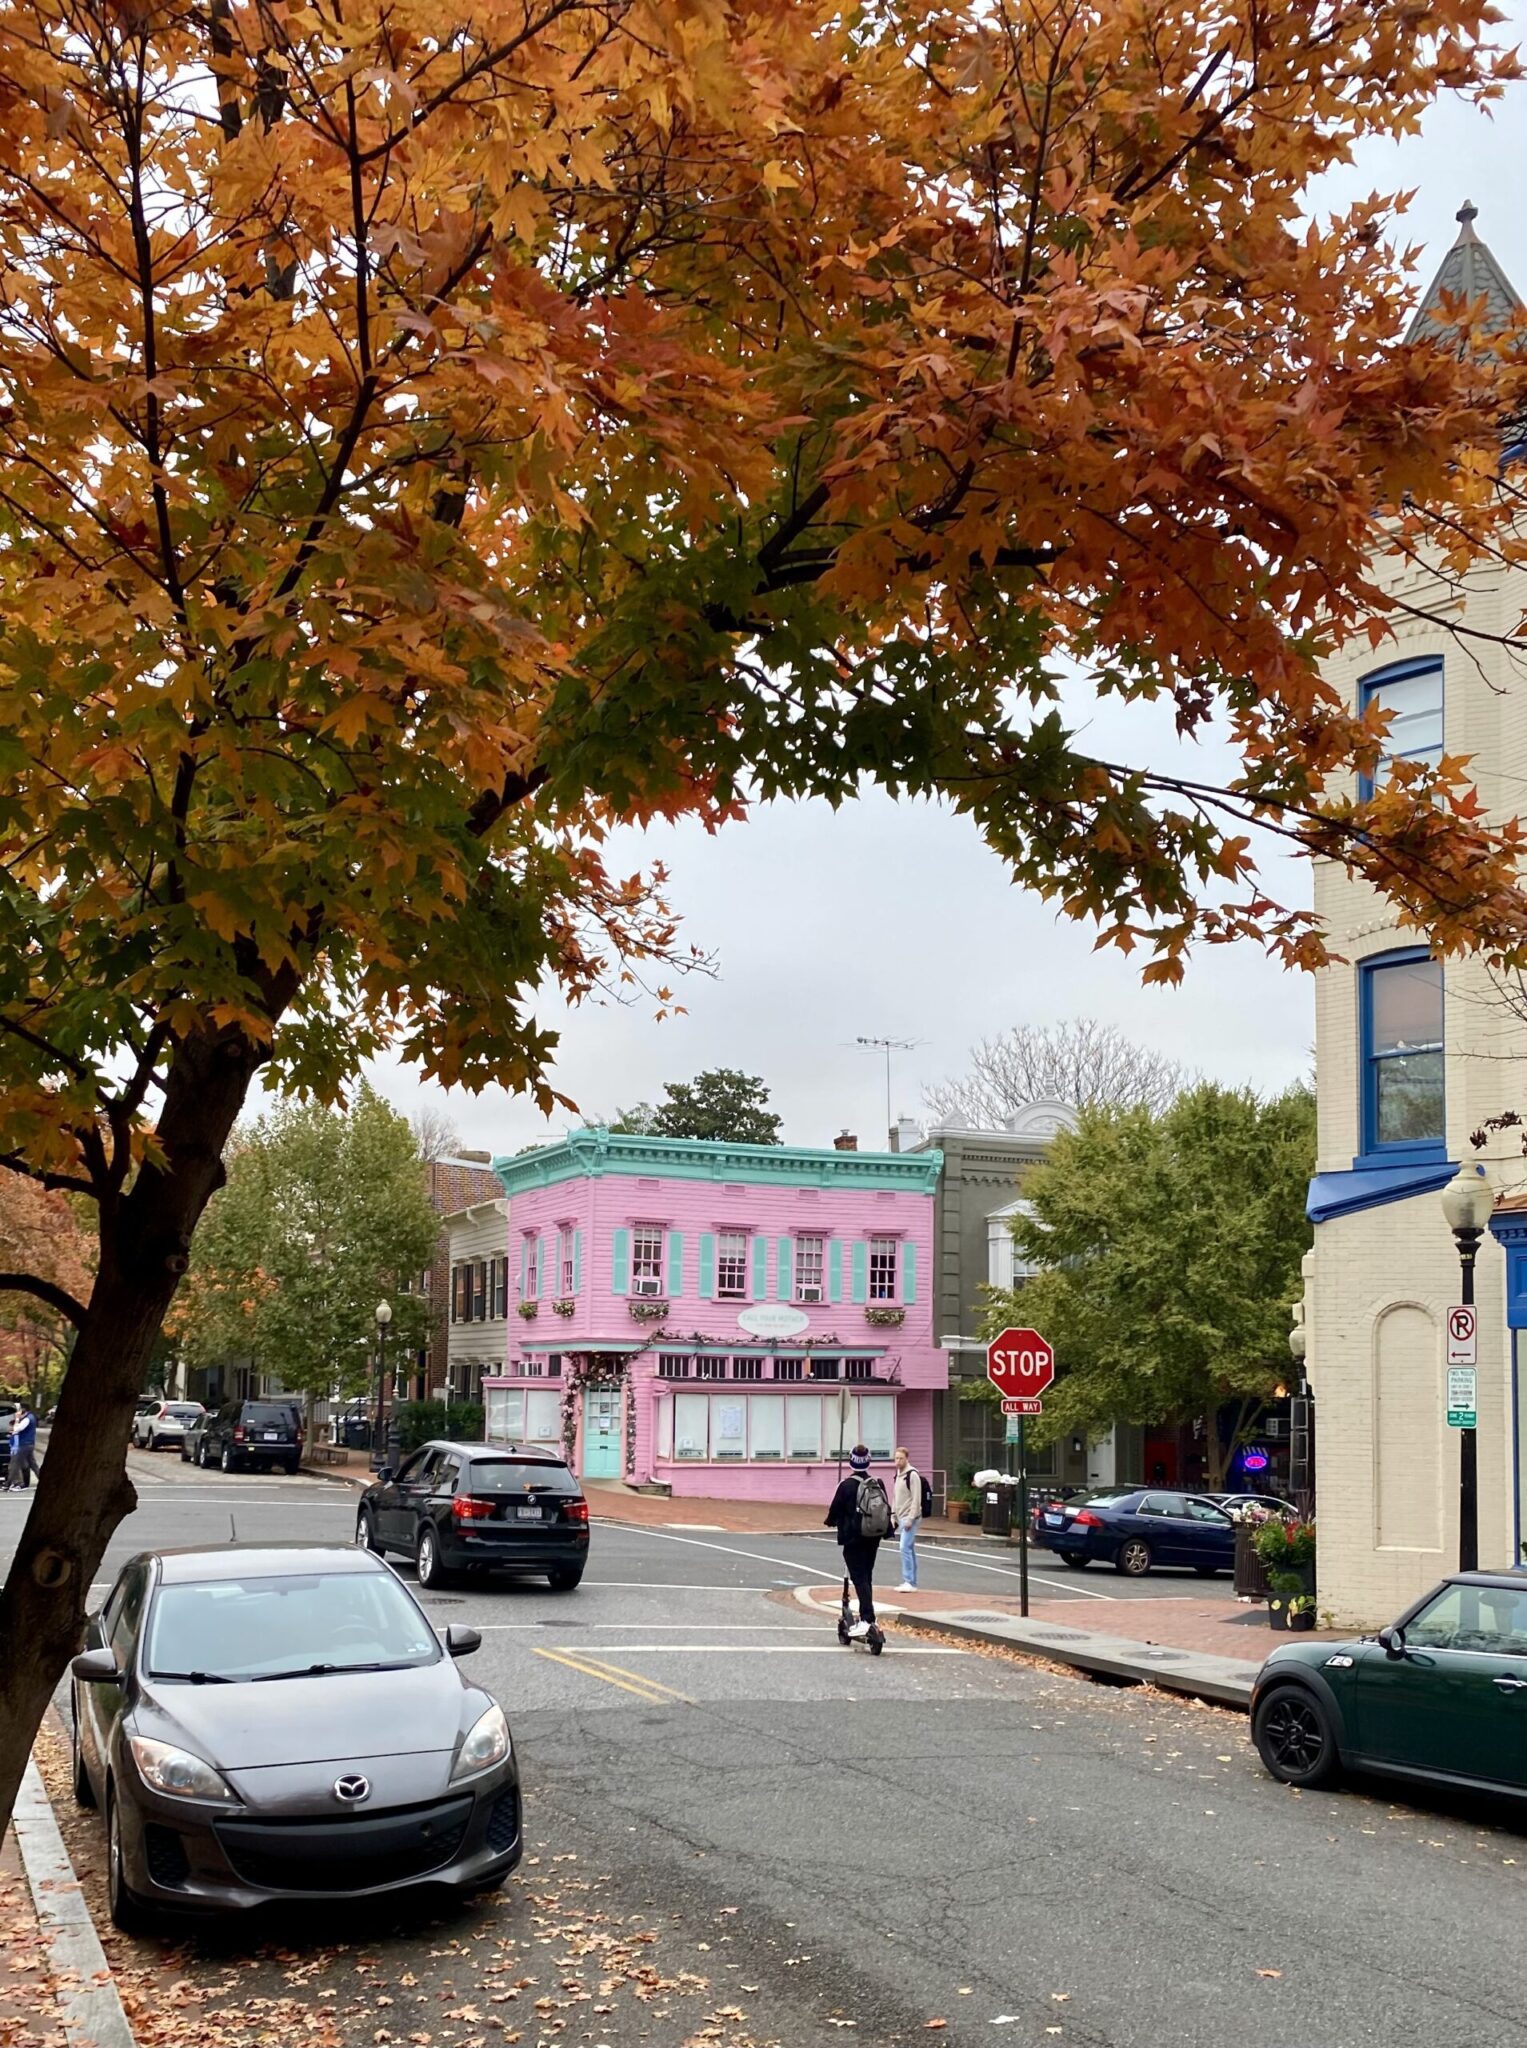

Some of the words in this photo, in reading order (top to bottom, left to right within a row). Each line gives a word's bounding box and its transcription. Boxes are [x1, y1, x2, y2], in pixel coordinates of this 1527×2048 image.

[992, 1350, 1049, 1376] STOP
[1005, 1402, 1019, 1411] ALL
[1022, 1402, 1038, 1411] WAY
